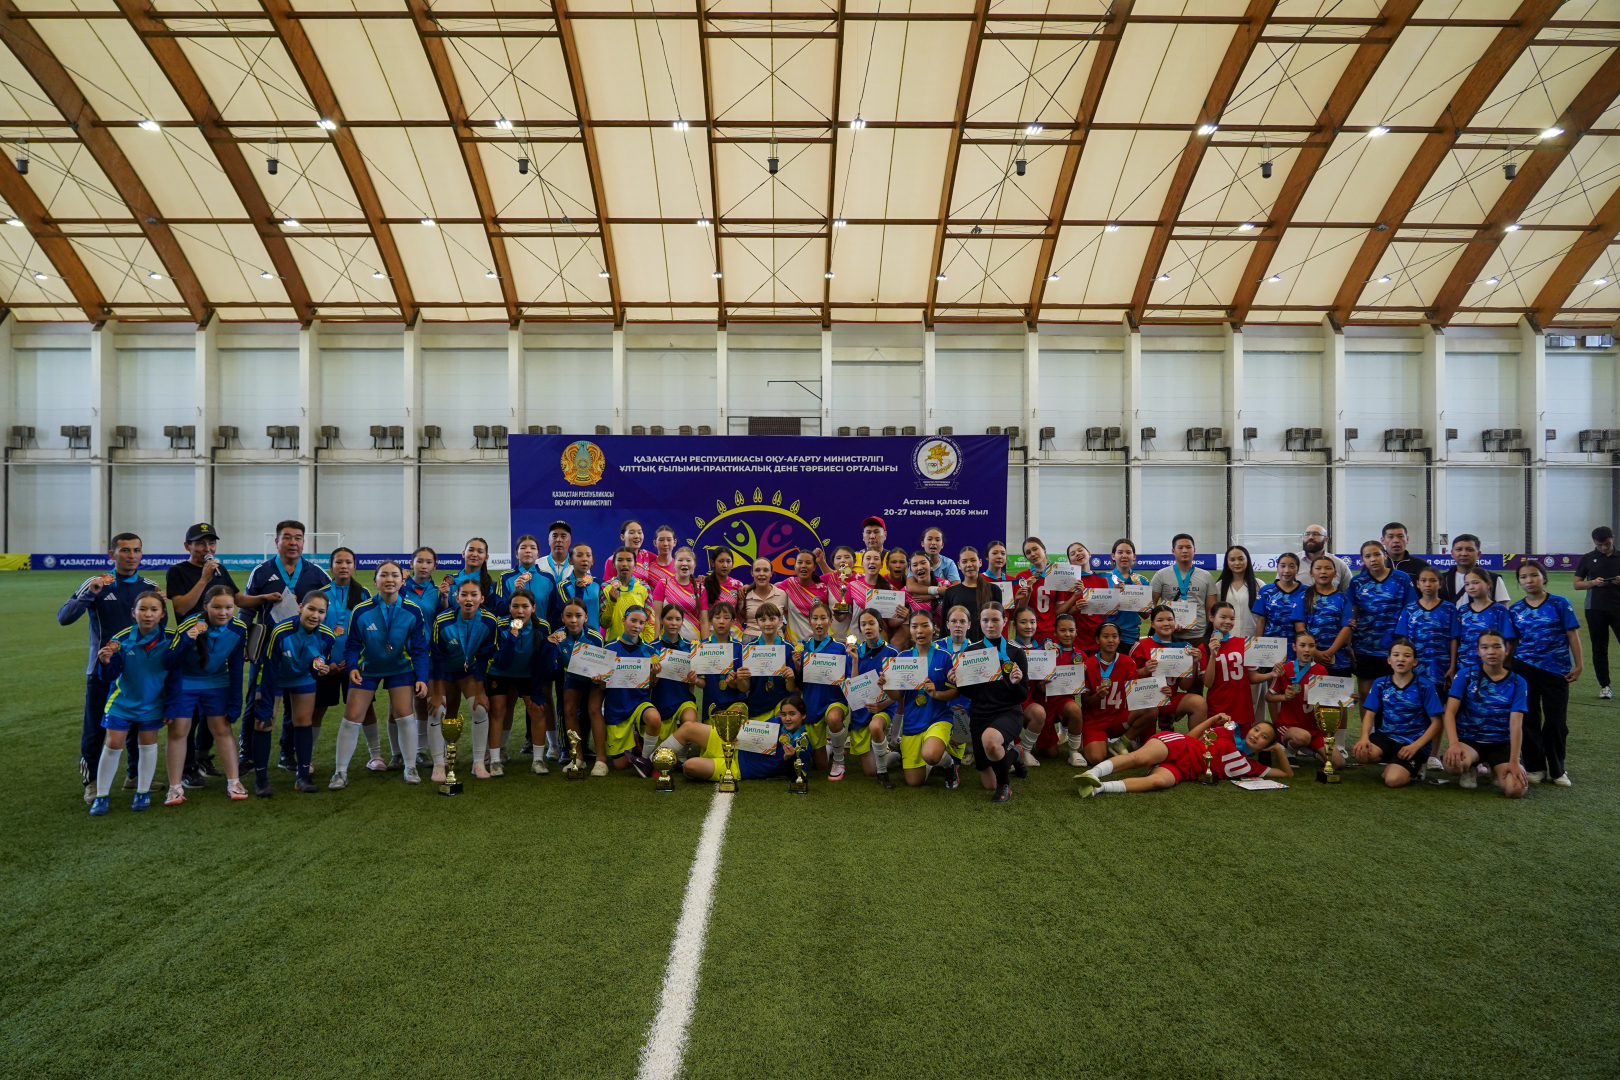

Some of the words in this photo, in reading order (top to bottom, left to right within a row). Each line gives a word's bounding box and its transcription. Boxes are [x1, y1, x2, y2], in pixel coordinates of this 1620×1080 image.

[1037, 586, 1050, 613] 6
[963, 656, 989, 666] ДИПЛОМ
[1216, 651, 1243, 682] 13
[1222, 751, 1251, 777] 10
